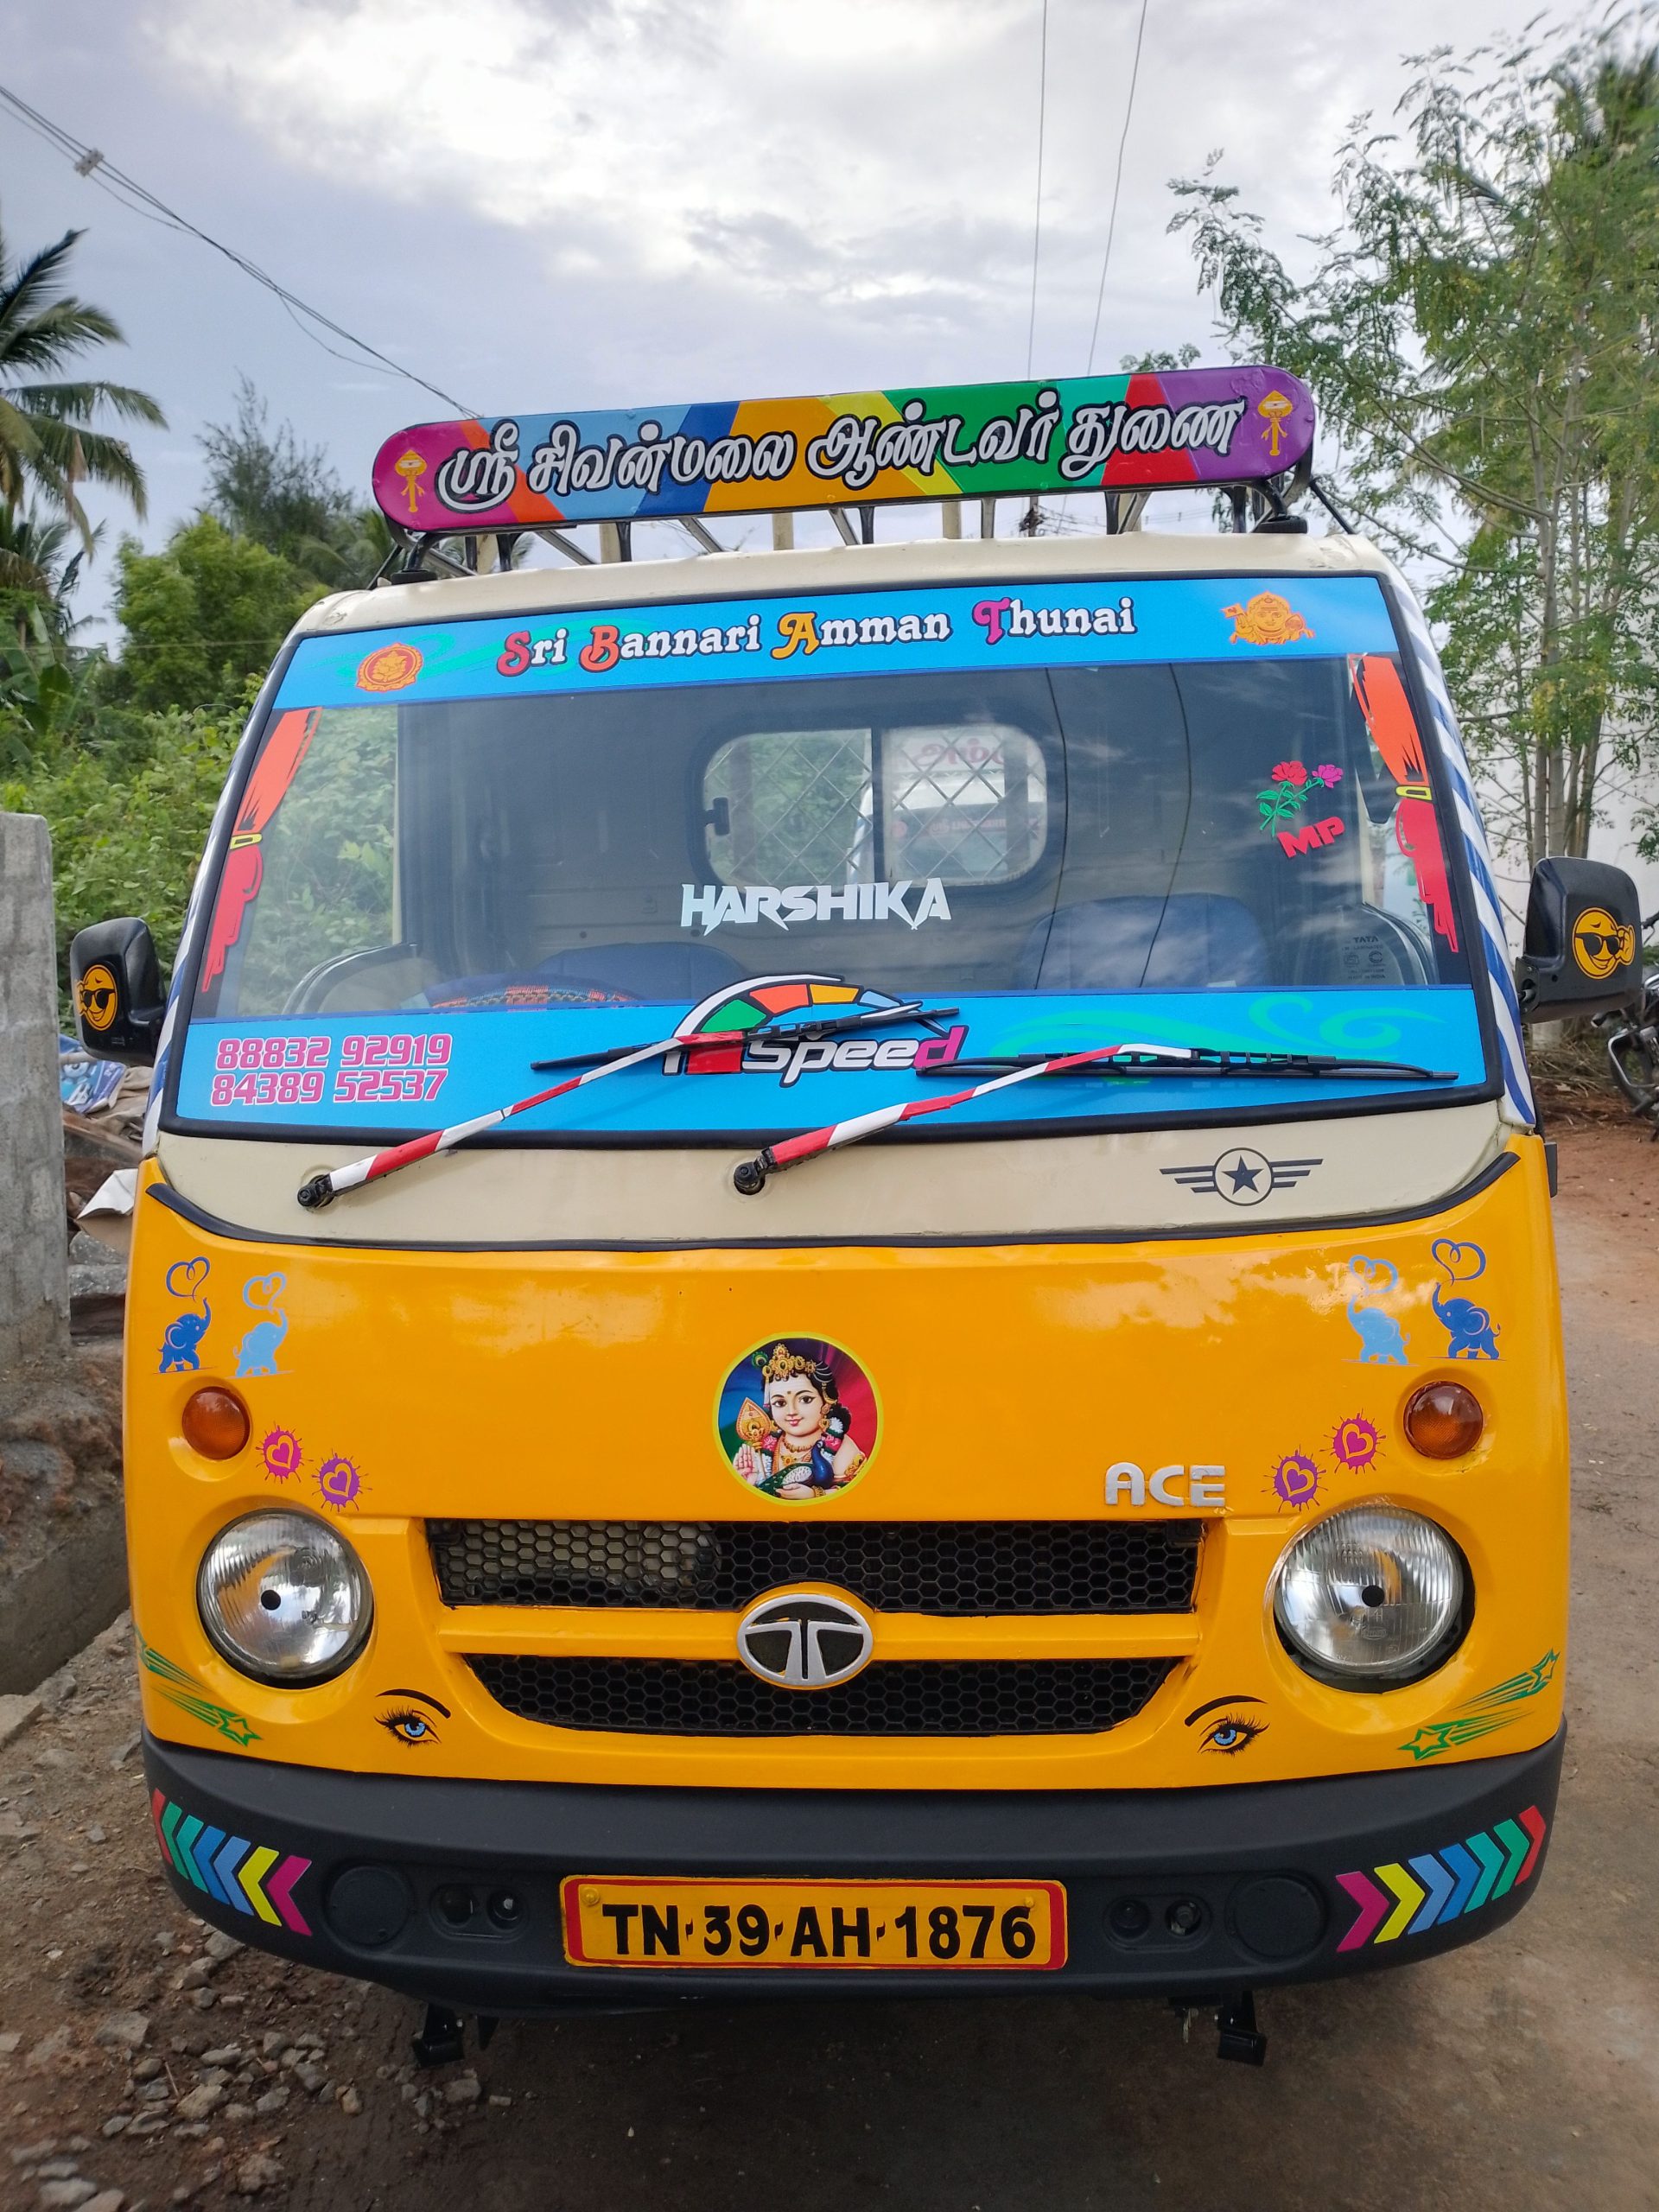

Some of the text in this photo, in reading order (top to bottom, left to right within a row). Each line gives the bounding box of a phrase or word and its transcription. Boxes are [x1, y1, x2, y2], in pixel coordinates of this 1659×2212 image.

[528, 421, 795, 495] சிவன்மலை
[808, 391, 1059, 486] ஆண்டவர்
[1061, 397, 1246, 477] துணை
[497, 597, 1135, 676] Sri Bannari Amman Thunai
[1277, 817, 1344, 858] MP
[681, 877, 951, 936] HARSHIKA
[216, 1033, 452, 1069] 88832 92919
[211, 1068, 448, 1106] 84389 52537
[1105, 1462, 1225, 1507] ACE
